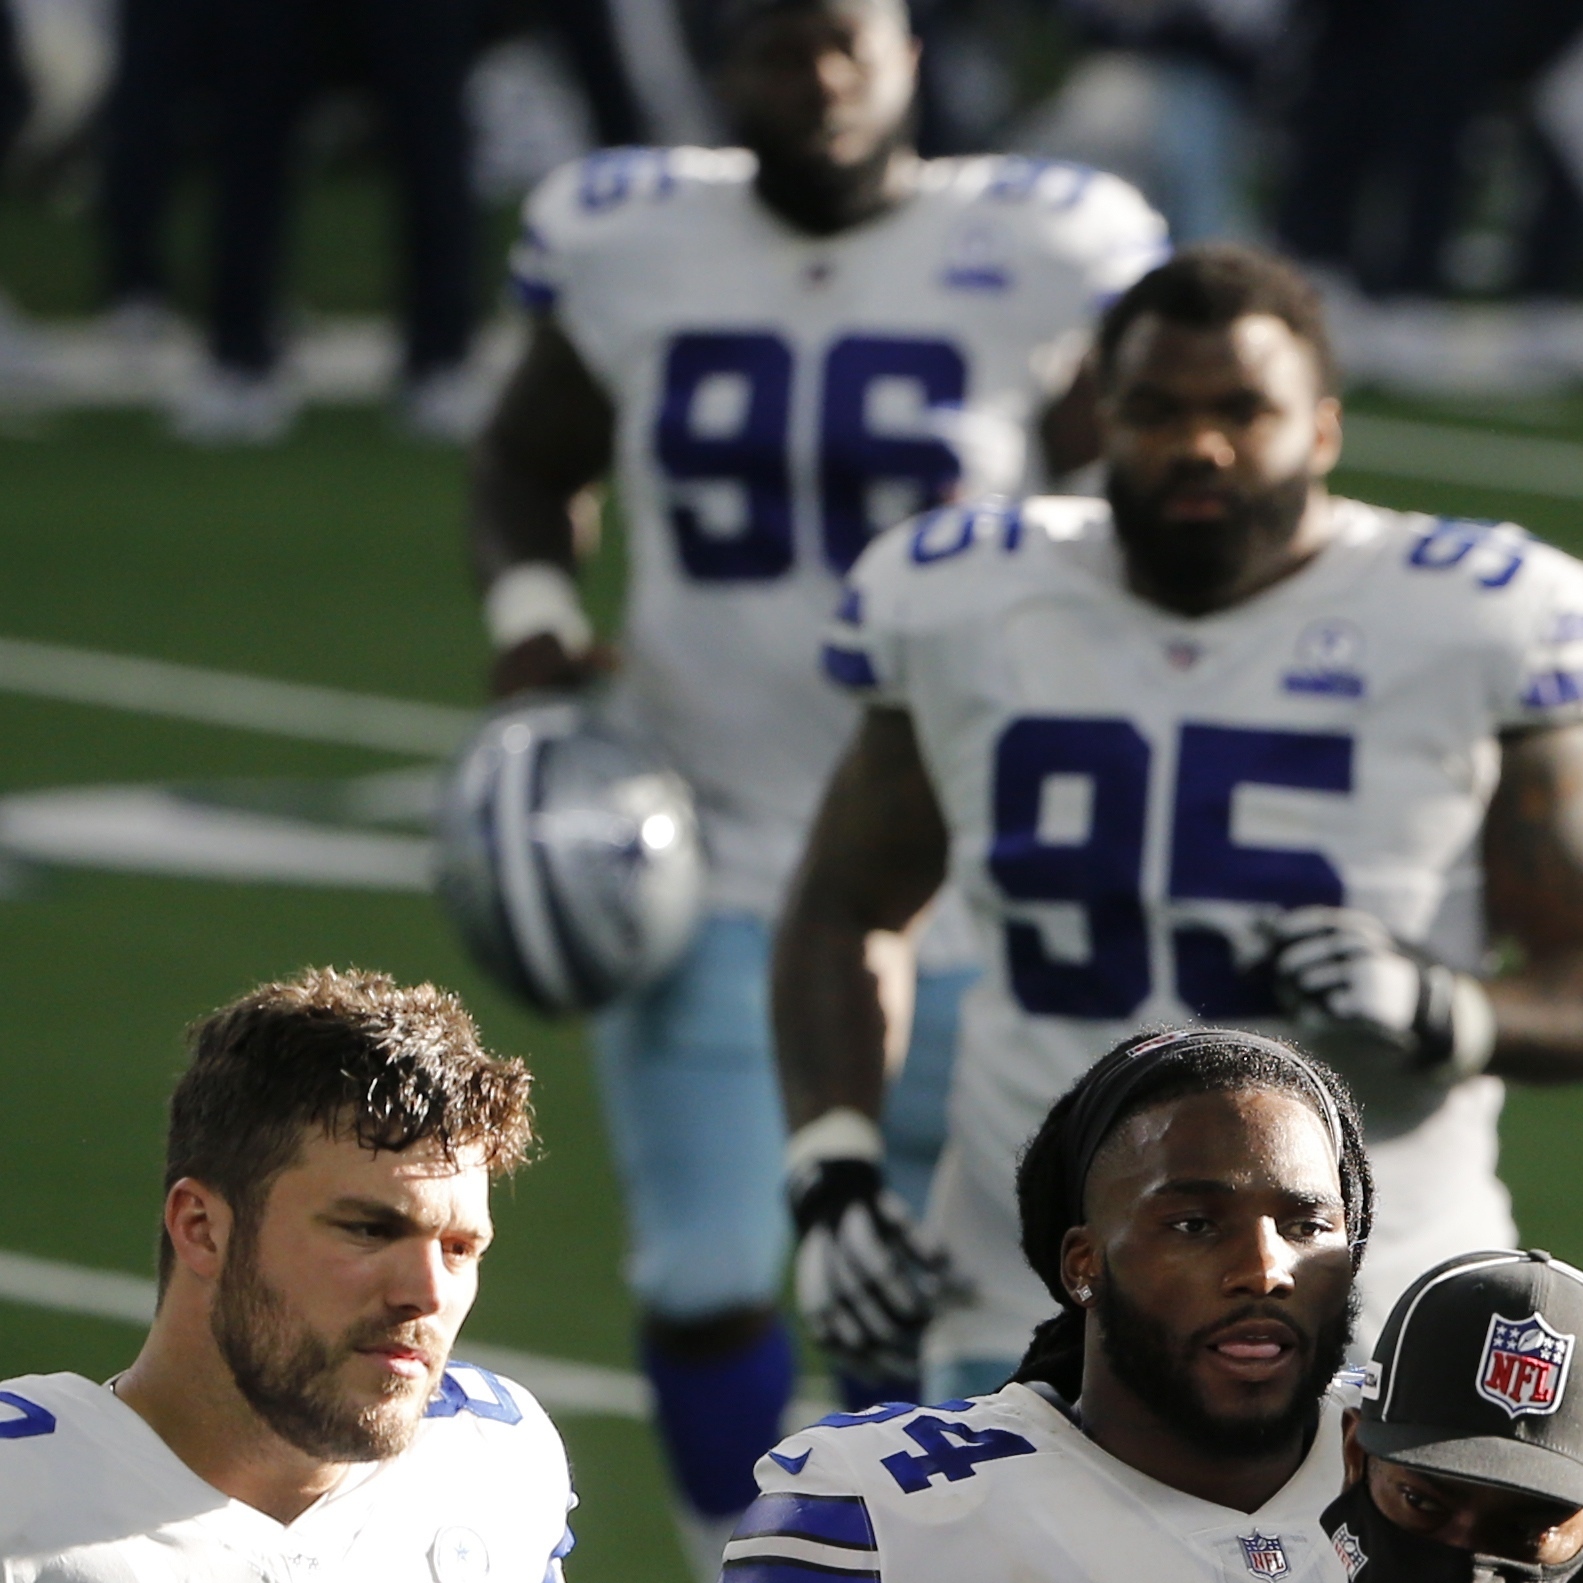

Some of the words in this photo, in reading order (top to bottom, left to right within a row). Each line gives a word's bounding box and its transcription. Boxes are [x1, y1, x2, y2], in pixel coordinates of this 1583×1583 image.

[657, 331, 966, 580] 96
[989, 715, 1355, 1020] 95
[1486, 1351, 1554, 1404] NFL
[1250, 1551, 1285, 1573] NFL
